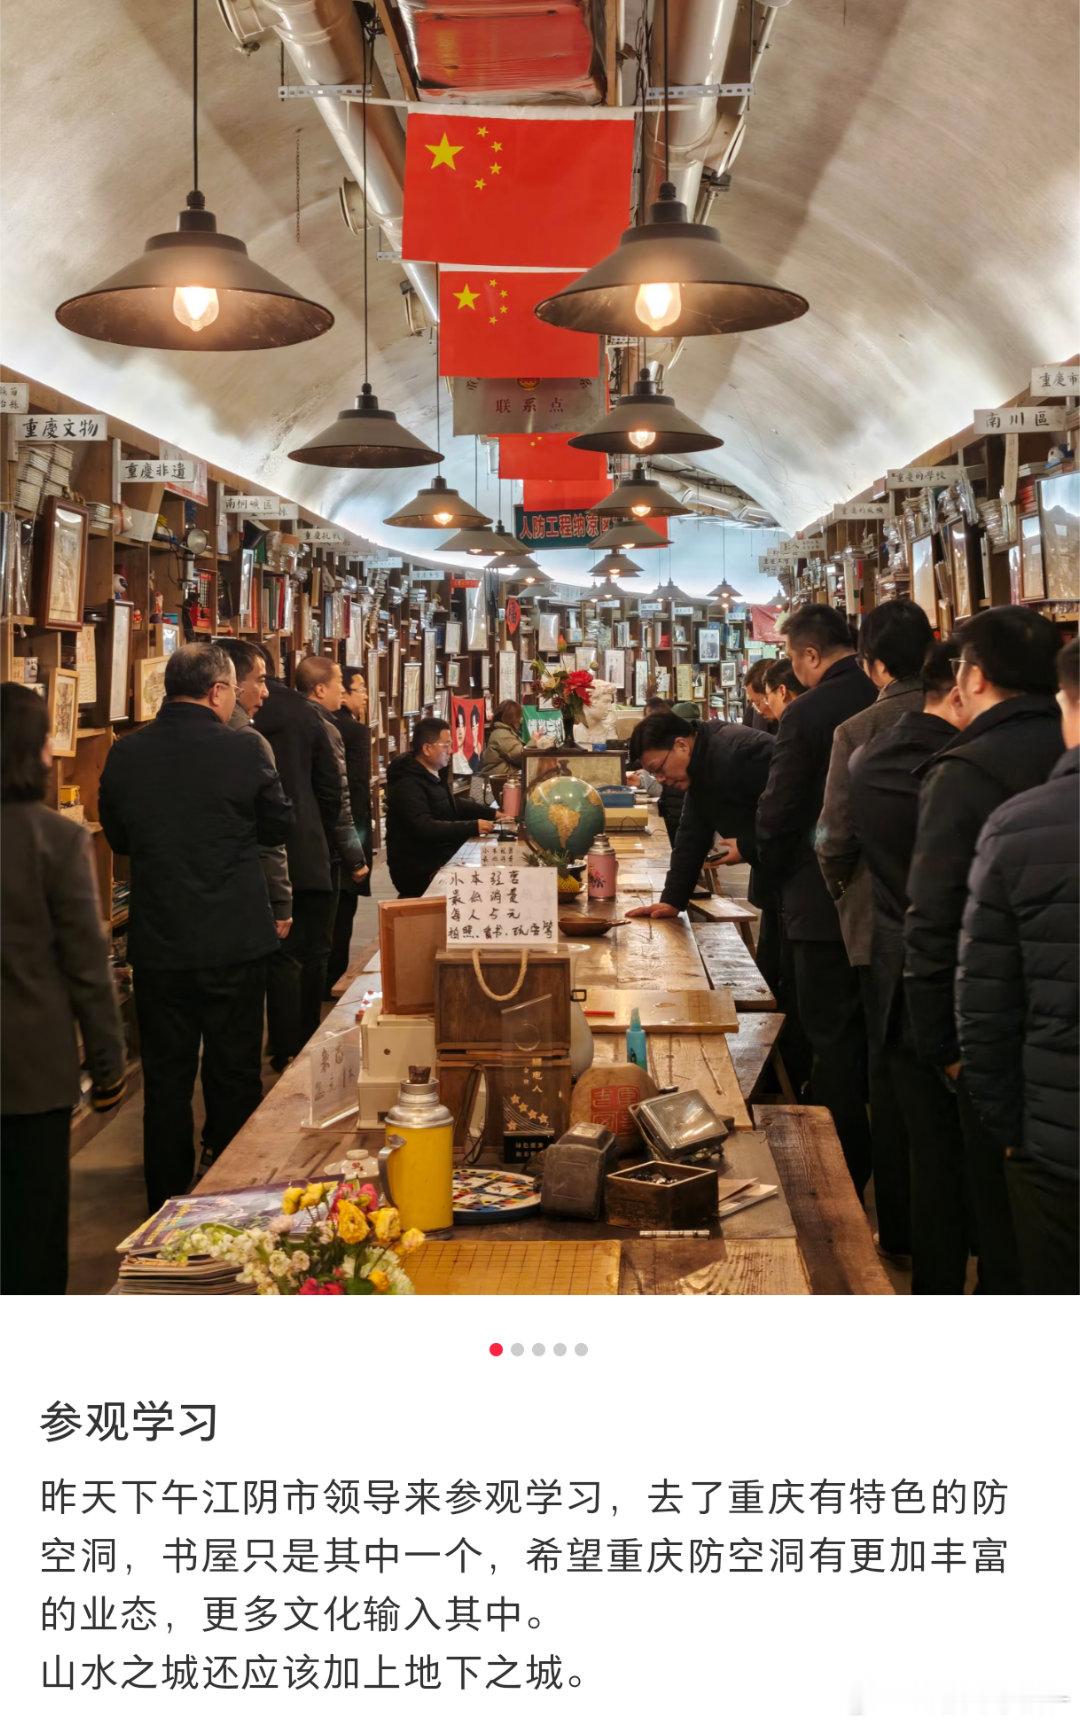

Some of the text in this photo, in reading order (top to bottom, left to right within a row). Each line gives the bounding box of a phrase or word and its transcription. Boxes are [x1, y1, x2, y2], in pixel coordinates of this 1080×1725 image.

[495, 397, 564, 414] 联系点
[22, 417, 99, 439] 重慶文物
[985, 410, 1050, 428] 南川區
[124, 462, 187, 480] 重慶非遺
[519, 513, 619, 540] 人防工程纳凉区
